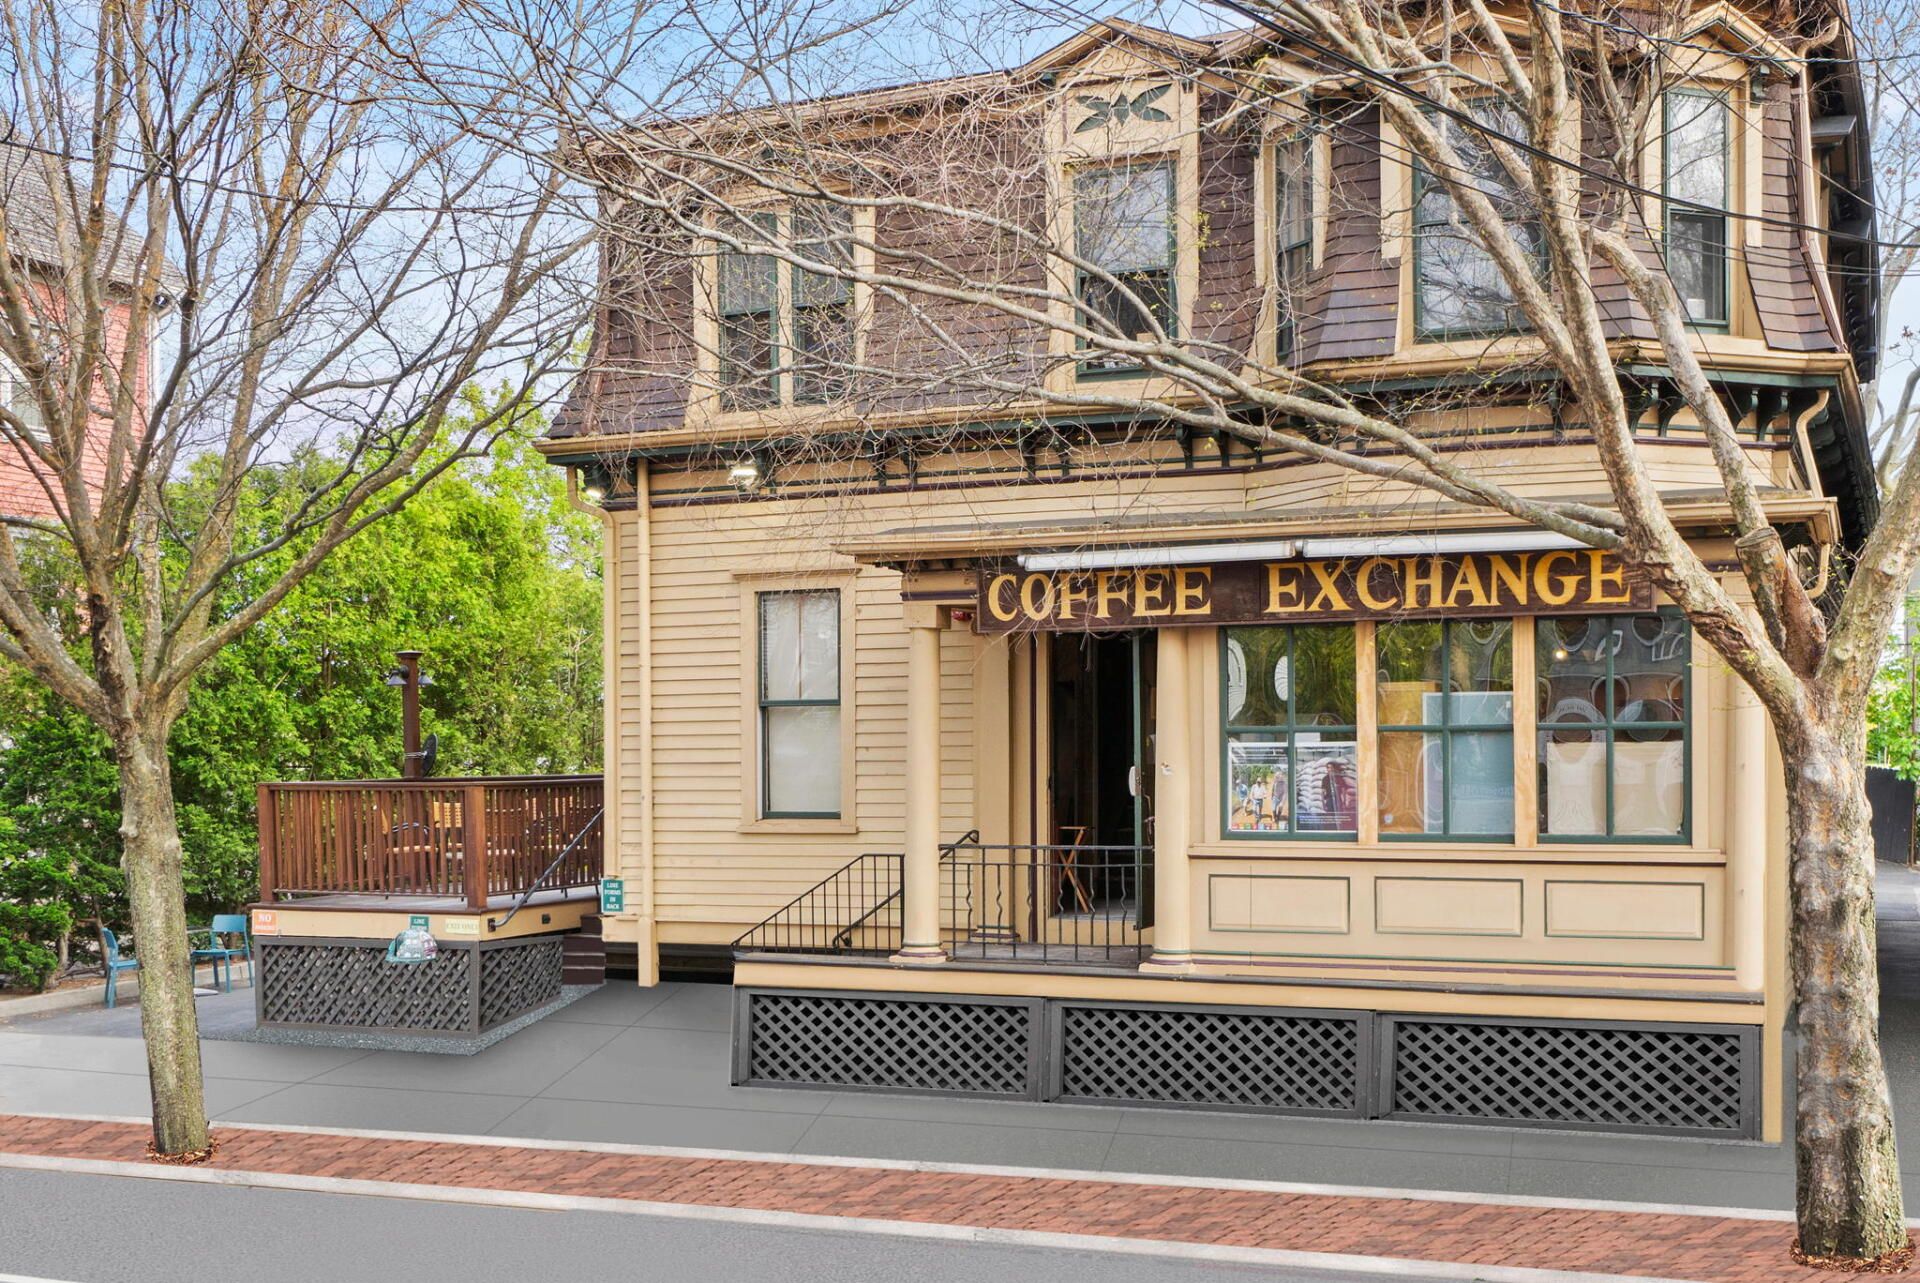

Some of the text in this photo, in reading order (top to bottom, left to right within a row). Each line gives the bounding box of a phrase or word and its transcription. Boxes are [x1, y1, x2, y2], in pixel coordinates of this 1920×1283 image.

[988, 549, 1631, 622] COFFEE EXCHANGE
[258, 914, 272, 922] NO
